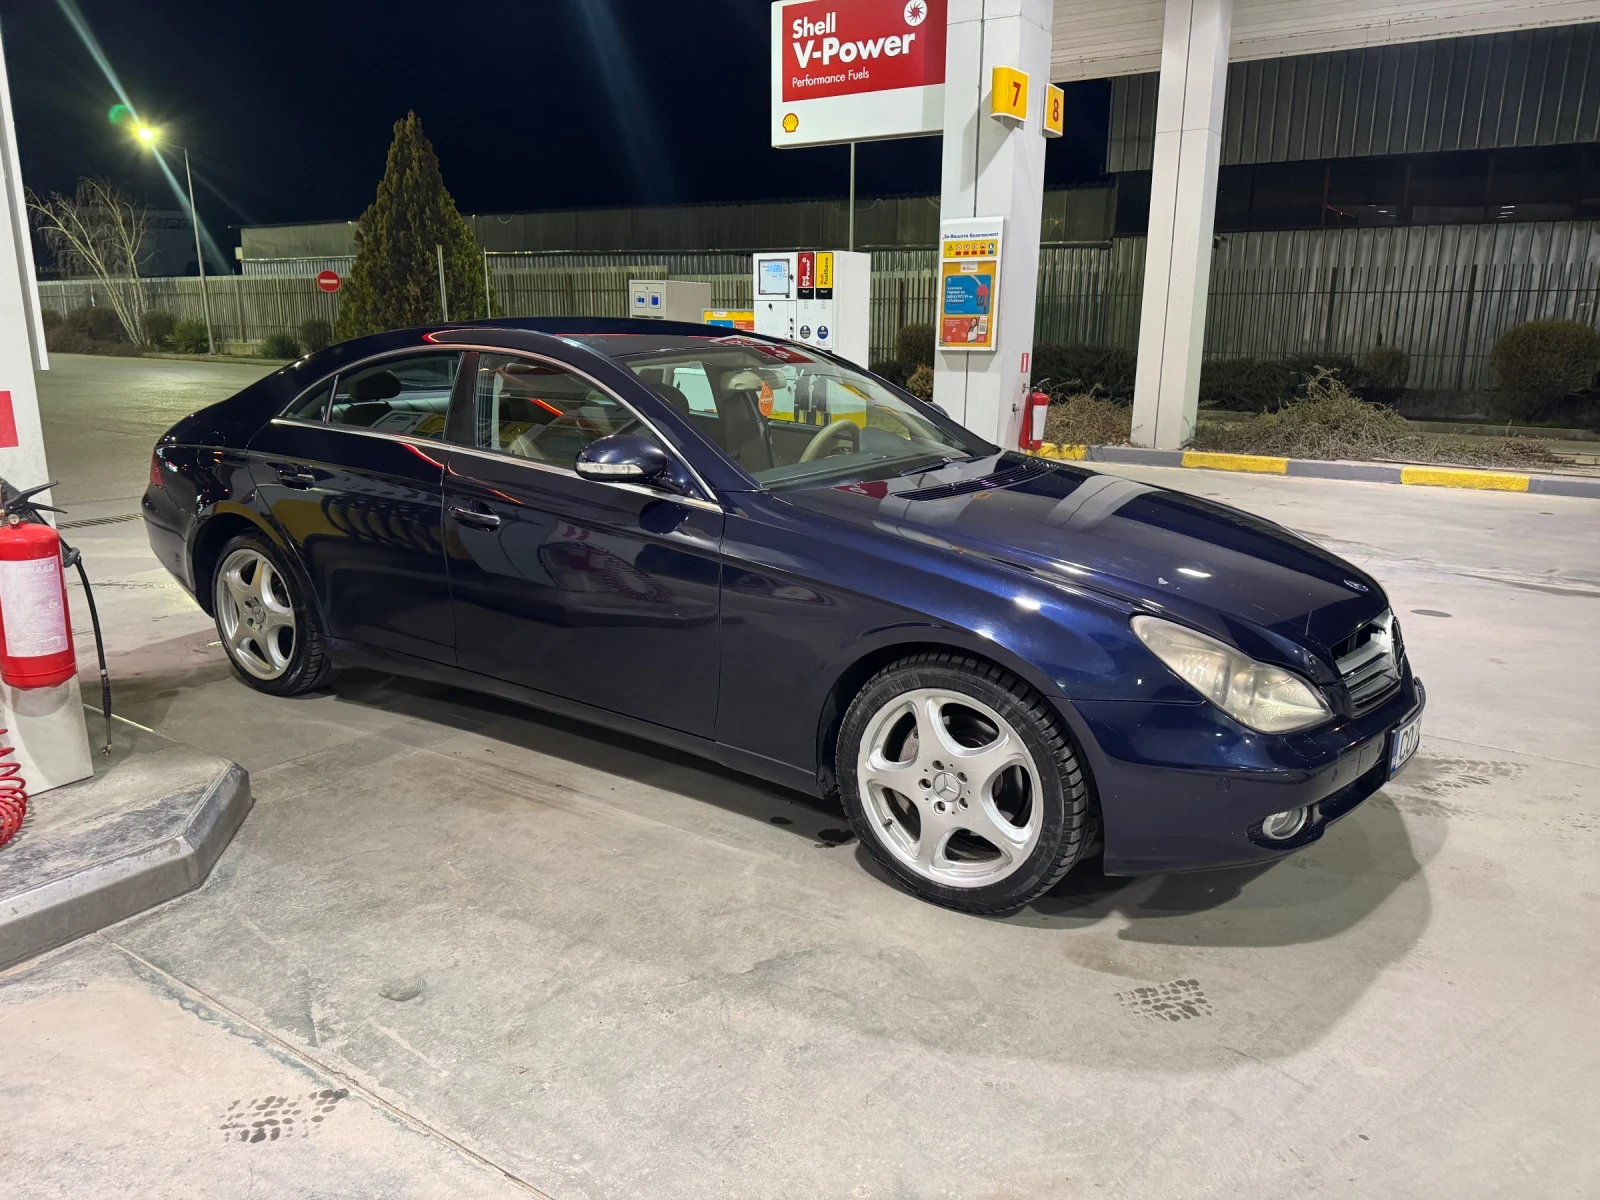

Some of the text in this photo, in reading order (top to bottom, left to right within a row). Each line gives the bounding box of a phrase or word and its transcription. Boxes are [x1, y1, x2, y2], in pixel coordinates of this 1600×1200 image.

[792, 11, 836, 39] Shell
[792, 32, 916, 69] V-Power
[792, 66, 870, 88] Performance Fuels
[1013, 81, 1021, 106] 7
[1053, 98, 1059, 122] 8
